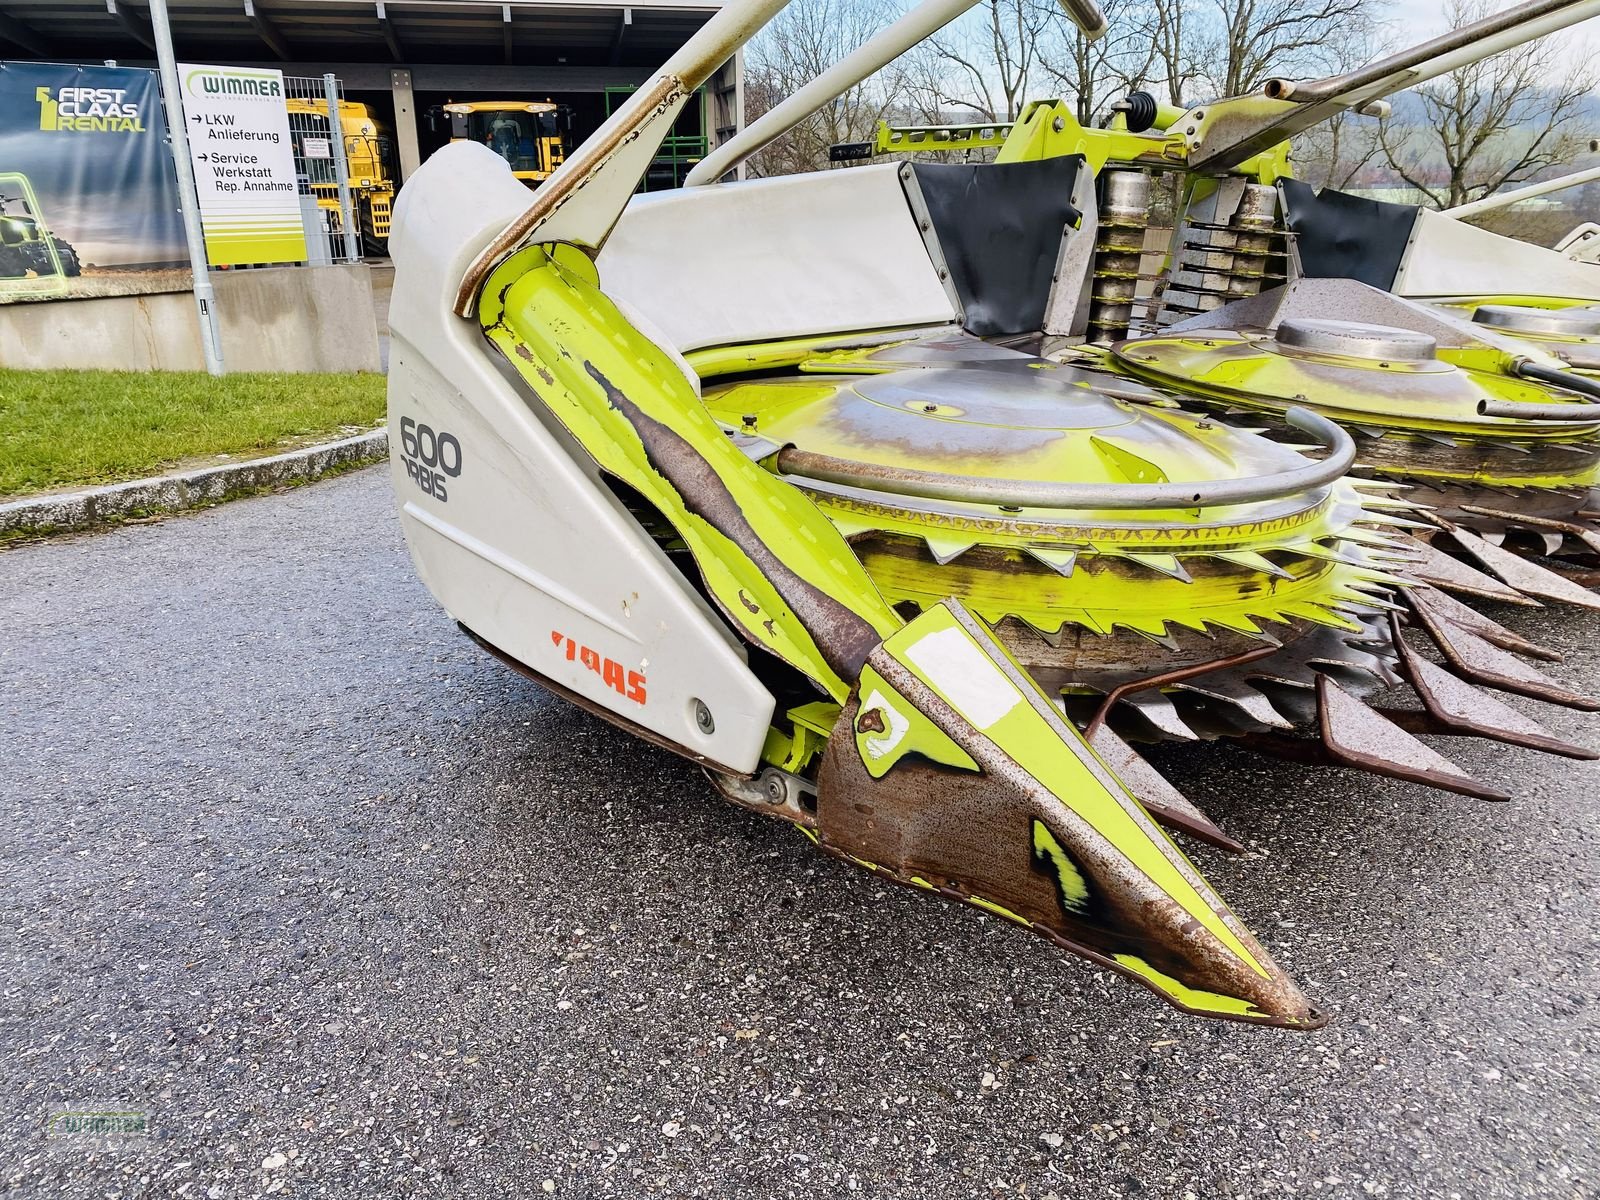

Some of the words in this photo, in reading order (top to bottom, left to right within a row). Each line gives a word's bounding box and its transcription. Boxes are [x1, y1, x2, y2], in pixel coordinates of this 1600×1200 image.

[202, 76, 281, 96] WIMMER
[58, 87, 127, 104] FIRST
[58, 102, 138, 118] CLAAS
[57, 116, 146, 132] RENTAL
[205, 113, 235, 126] LKW
[208, 128, 280, 144] Anlieferung
[211, 152, 258, 164] Service
[212, 166, 273, 178] Werkstatt
[215, 180, 241, 194] Rep.
[243, 180, 294, 192] Annahme
[400, 415, 463, 478] 600
